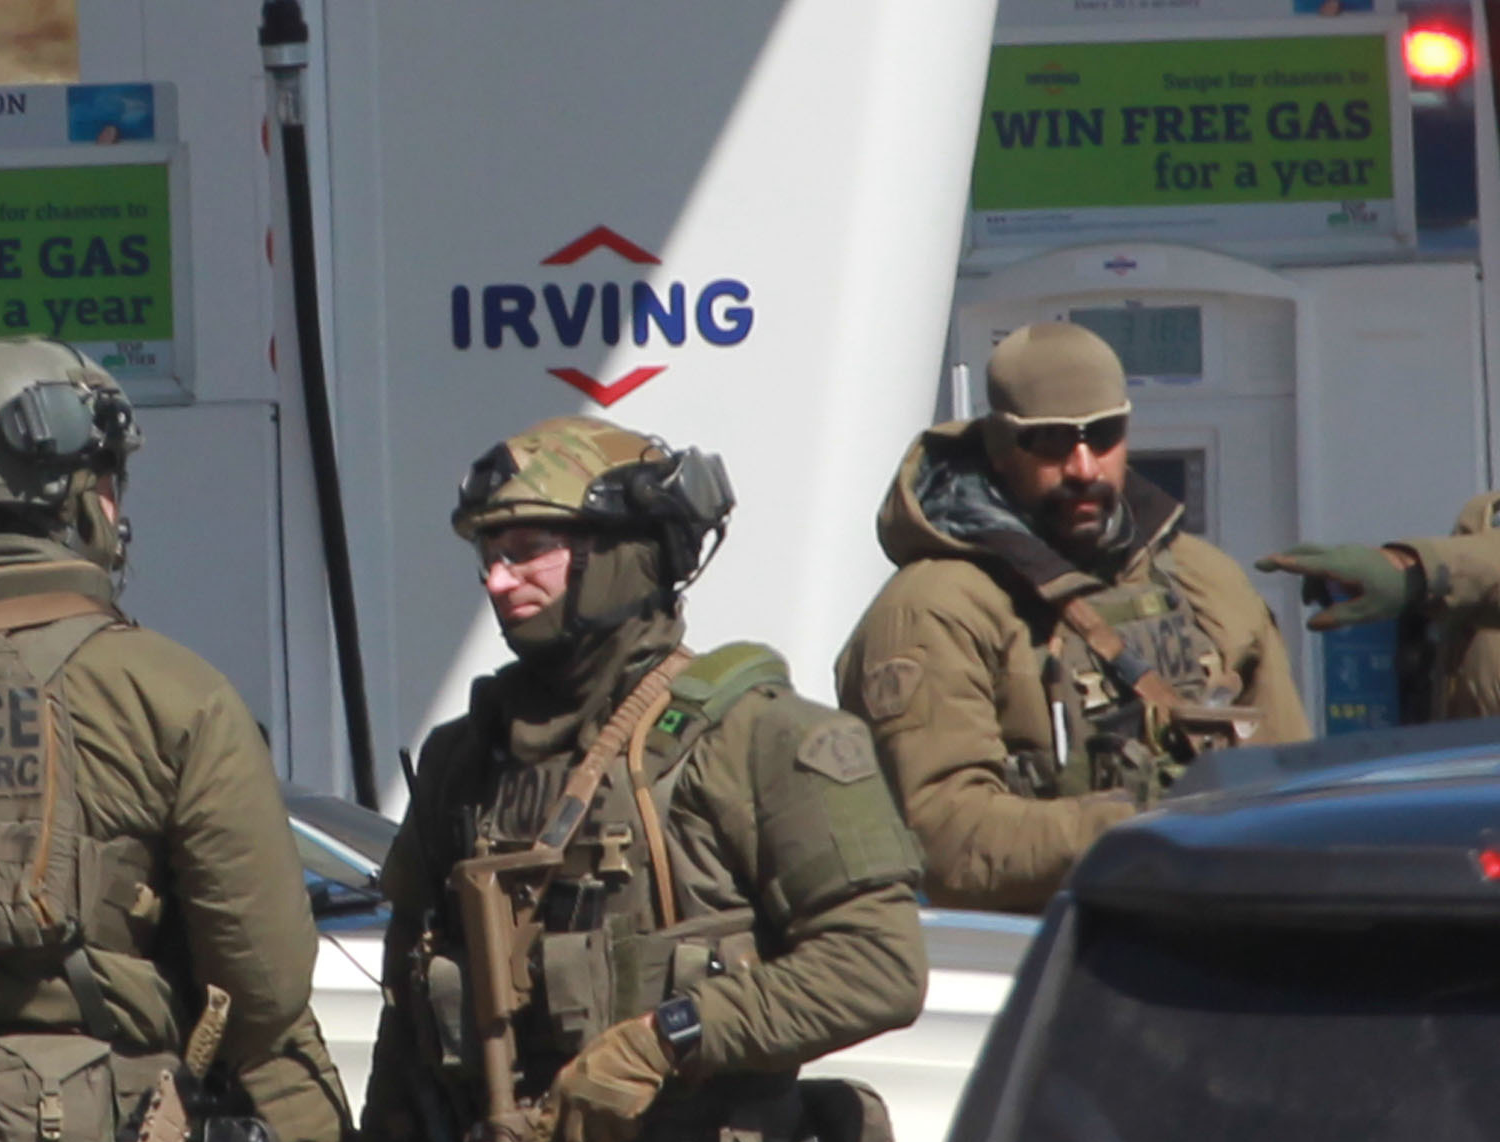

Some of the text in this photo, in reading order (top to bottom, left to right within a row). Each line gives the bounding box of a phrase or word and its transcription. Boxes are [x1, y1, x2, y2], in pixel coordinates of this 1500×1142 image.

[1162, 73, 1223, 93] Swipe
[1230, 71, 1257, 88] for
[1348, 69, 1369, 85] to
[990, 100, 1373, 149] WIN FREE GAS
[1153, 152, 1375, 197] for a year
[0, 202, 30, 221] for
[35, 202, 121, 220] chances
[127, 202, 149, 218] to
[38, 234, 151, 279] GAS
[3, 299, 30, 328] a
[43, 295, 154, 336] year
[451, 279, 754, 350] IRVING
[497, 769, 612, 836] POLE
